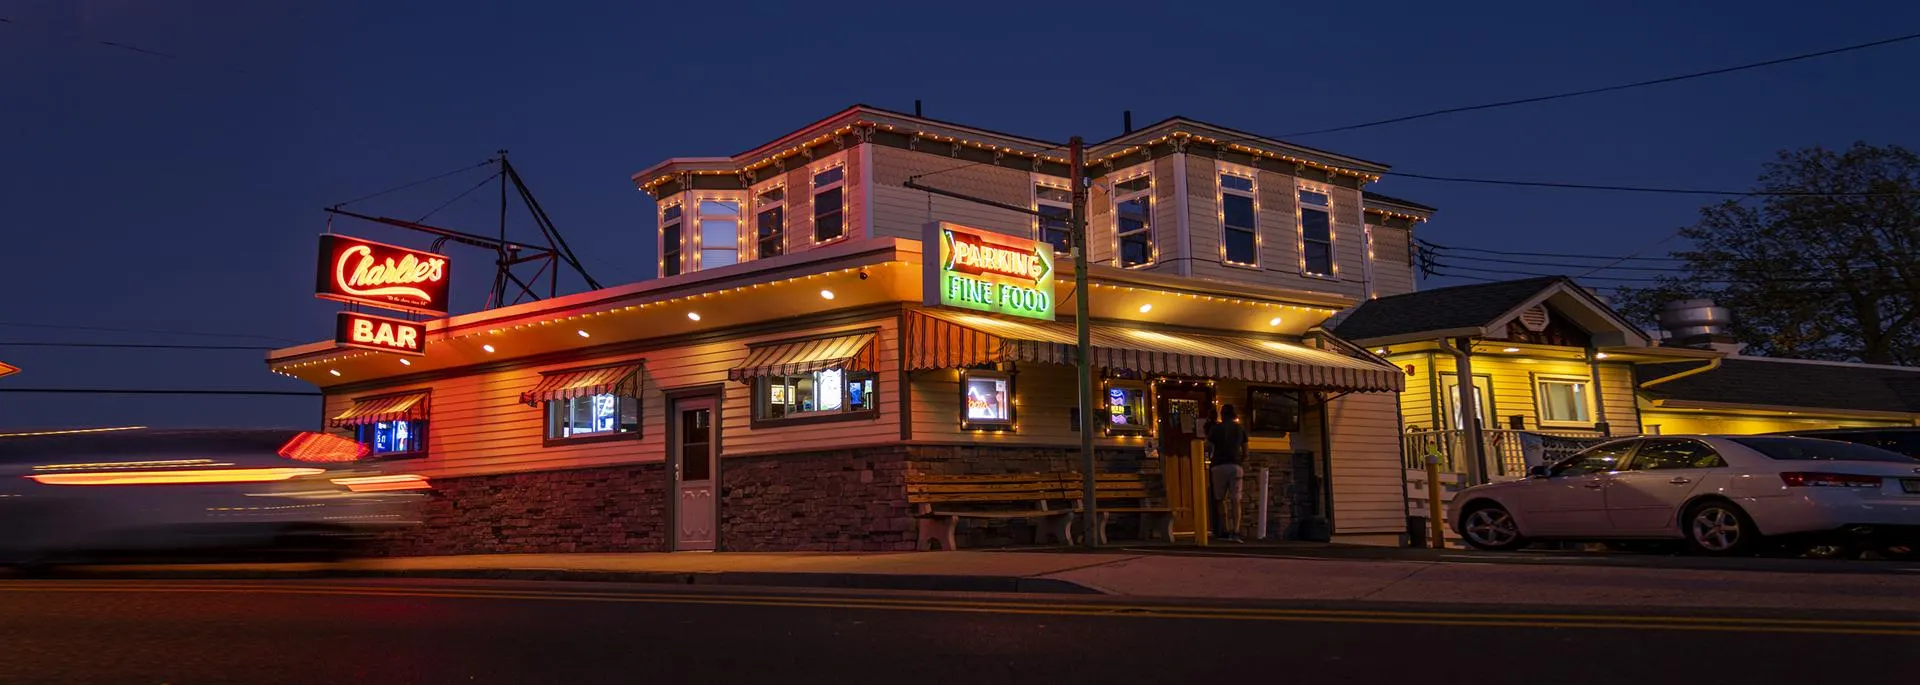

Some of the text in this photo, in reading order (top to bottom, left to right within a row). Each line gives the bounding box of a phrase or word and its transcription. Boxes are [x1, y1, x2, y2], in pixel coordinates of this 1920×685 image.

[336, 245, 446, 301] Charlie's
[955, 241, 1043, 278] PARKING
[948, 276, 1050, 313] FINE FOOD
[352, 318, 417, 350] BAR
